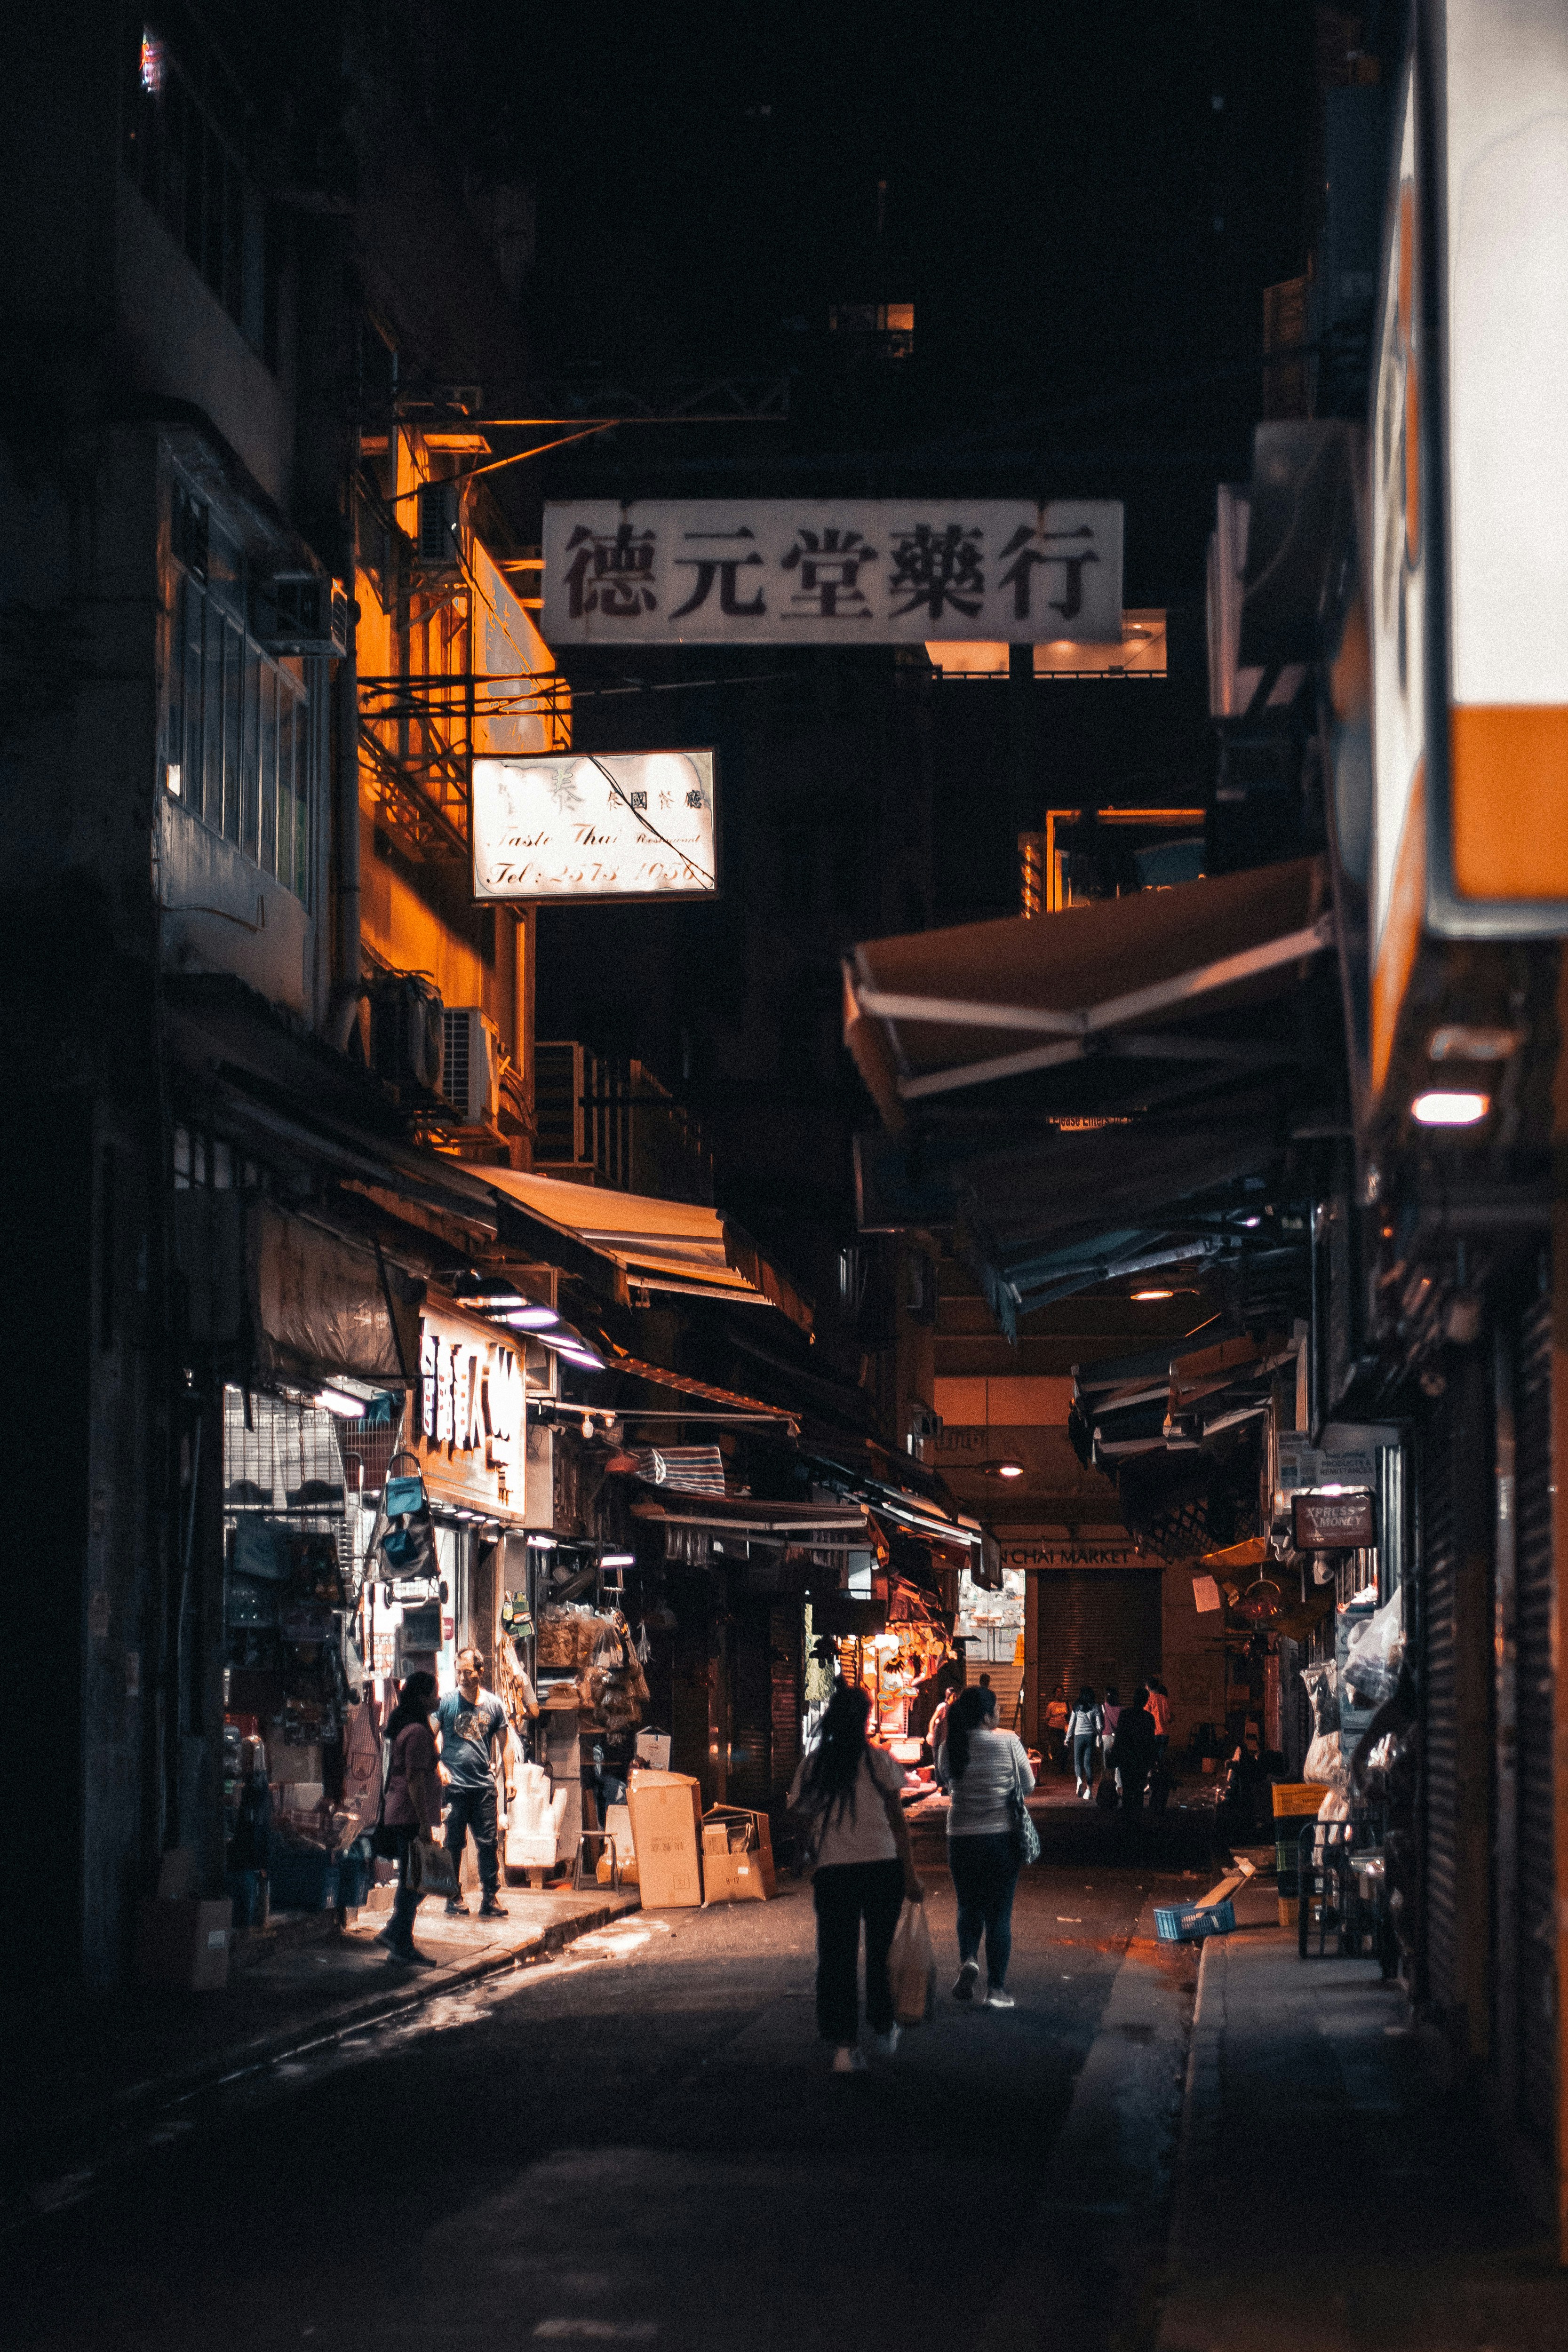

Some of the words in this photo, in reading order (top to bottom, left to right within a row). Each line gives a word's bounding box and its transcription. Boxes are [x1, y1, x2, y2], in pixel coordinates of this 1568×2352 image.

[563, 522, 1099, 620] 德元堂藥行
[571, 823, 619, 845] Thai
[1320, 1516, 1362, 1527] MONEY
[1011, 1549, 1054, 1565] CHAI
[1061, 1549, 1130, 1564] MARKET
